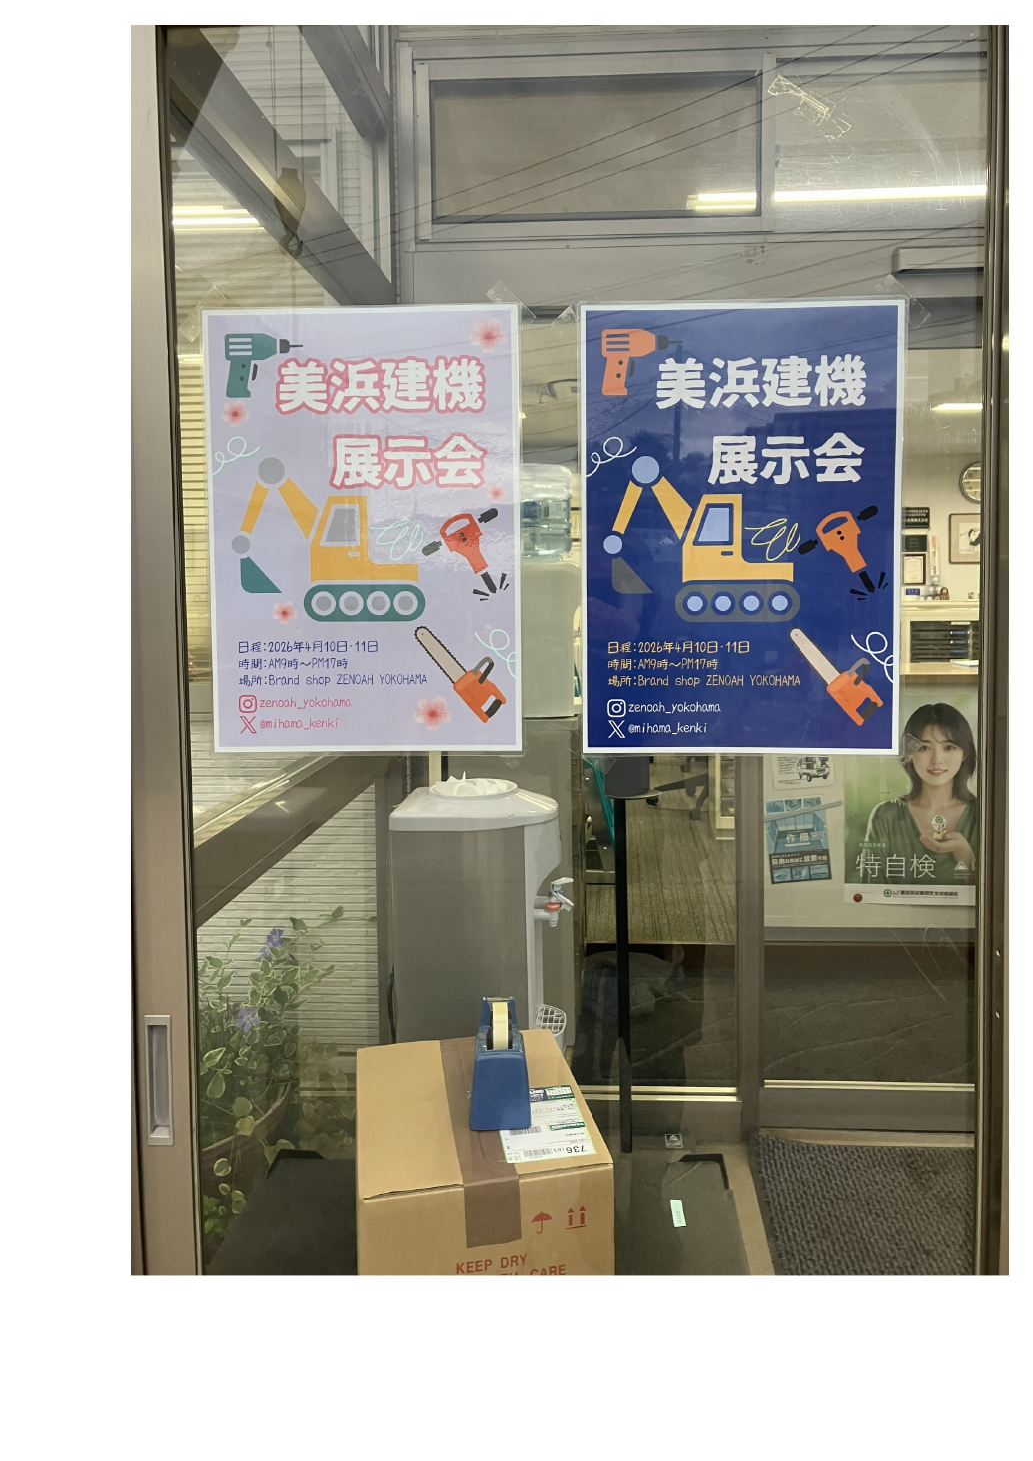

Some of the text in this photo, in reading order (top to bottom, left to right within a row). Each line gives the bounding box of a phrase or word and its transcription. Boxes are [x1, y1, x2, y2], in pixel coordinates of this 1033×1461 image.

[276, 357, 486, 413] 美浜建機
[656, 354, 867, 409] 美浜建機
[330, 433, 487, 489] 展示会
[708, 432, 865, 485] 展示会
[305, 674, 331, 686] shop
[336, 673, 375, 686] ZENOAH
[379, 673, 428, 686] YOKOHAMA
[675, 675, 700, 687] shop
[706, 674, 743, 687] ZENOAH
[750, 674, 801, 687] YOKOHAMA
[260, 696, 352, 710] zenoah_yokohama
[628, 700, 721, 715] zenoah_yokohama
[260, 717, 339, 730] @mihama_kenki
[628, 721, 707, 735] @mihama_kenki
[855, 853, 937, 879] 特自検
[456, 1254, 528, 1275] KEEP DRY
